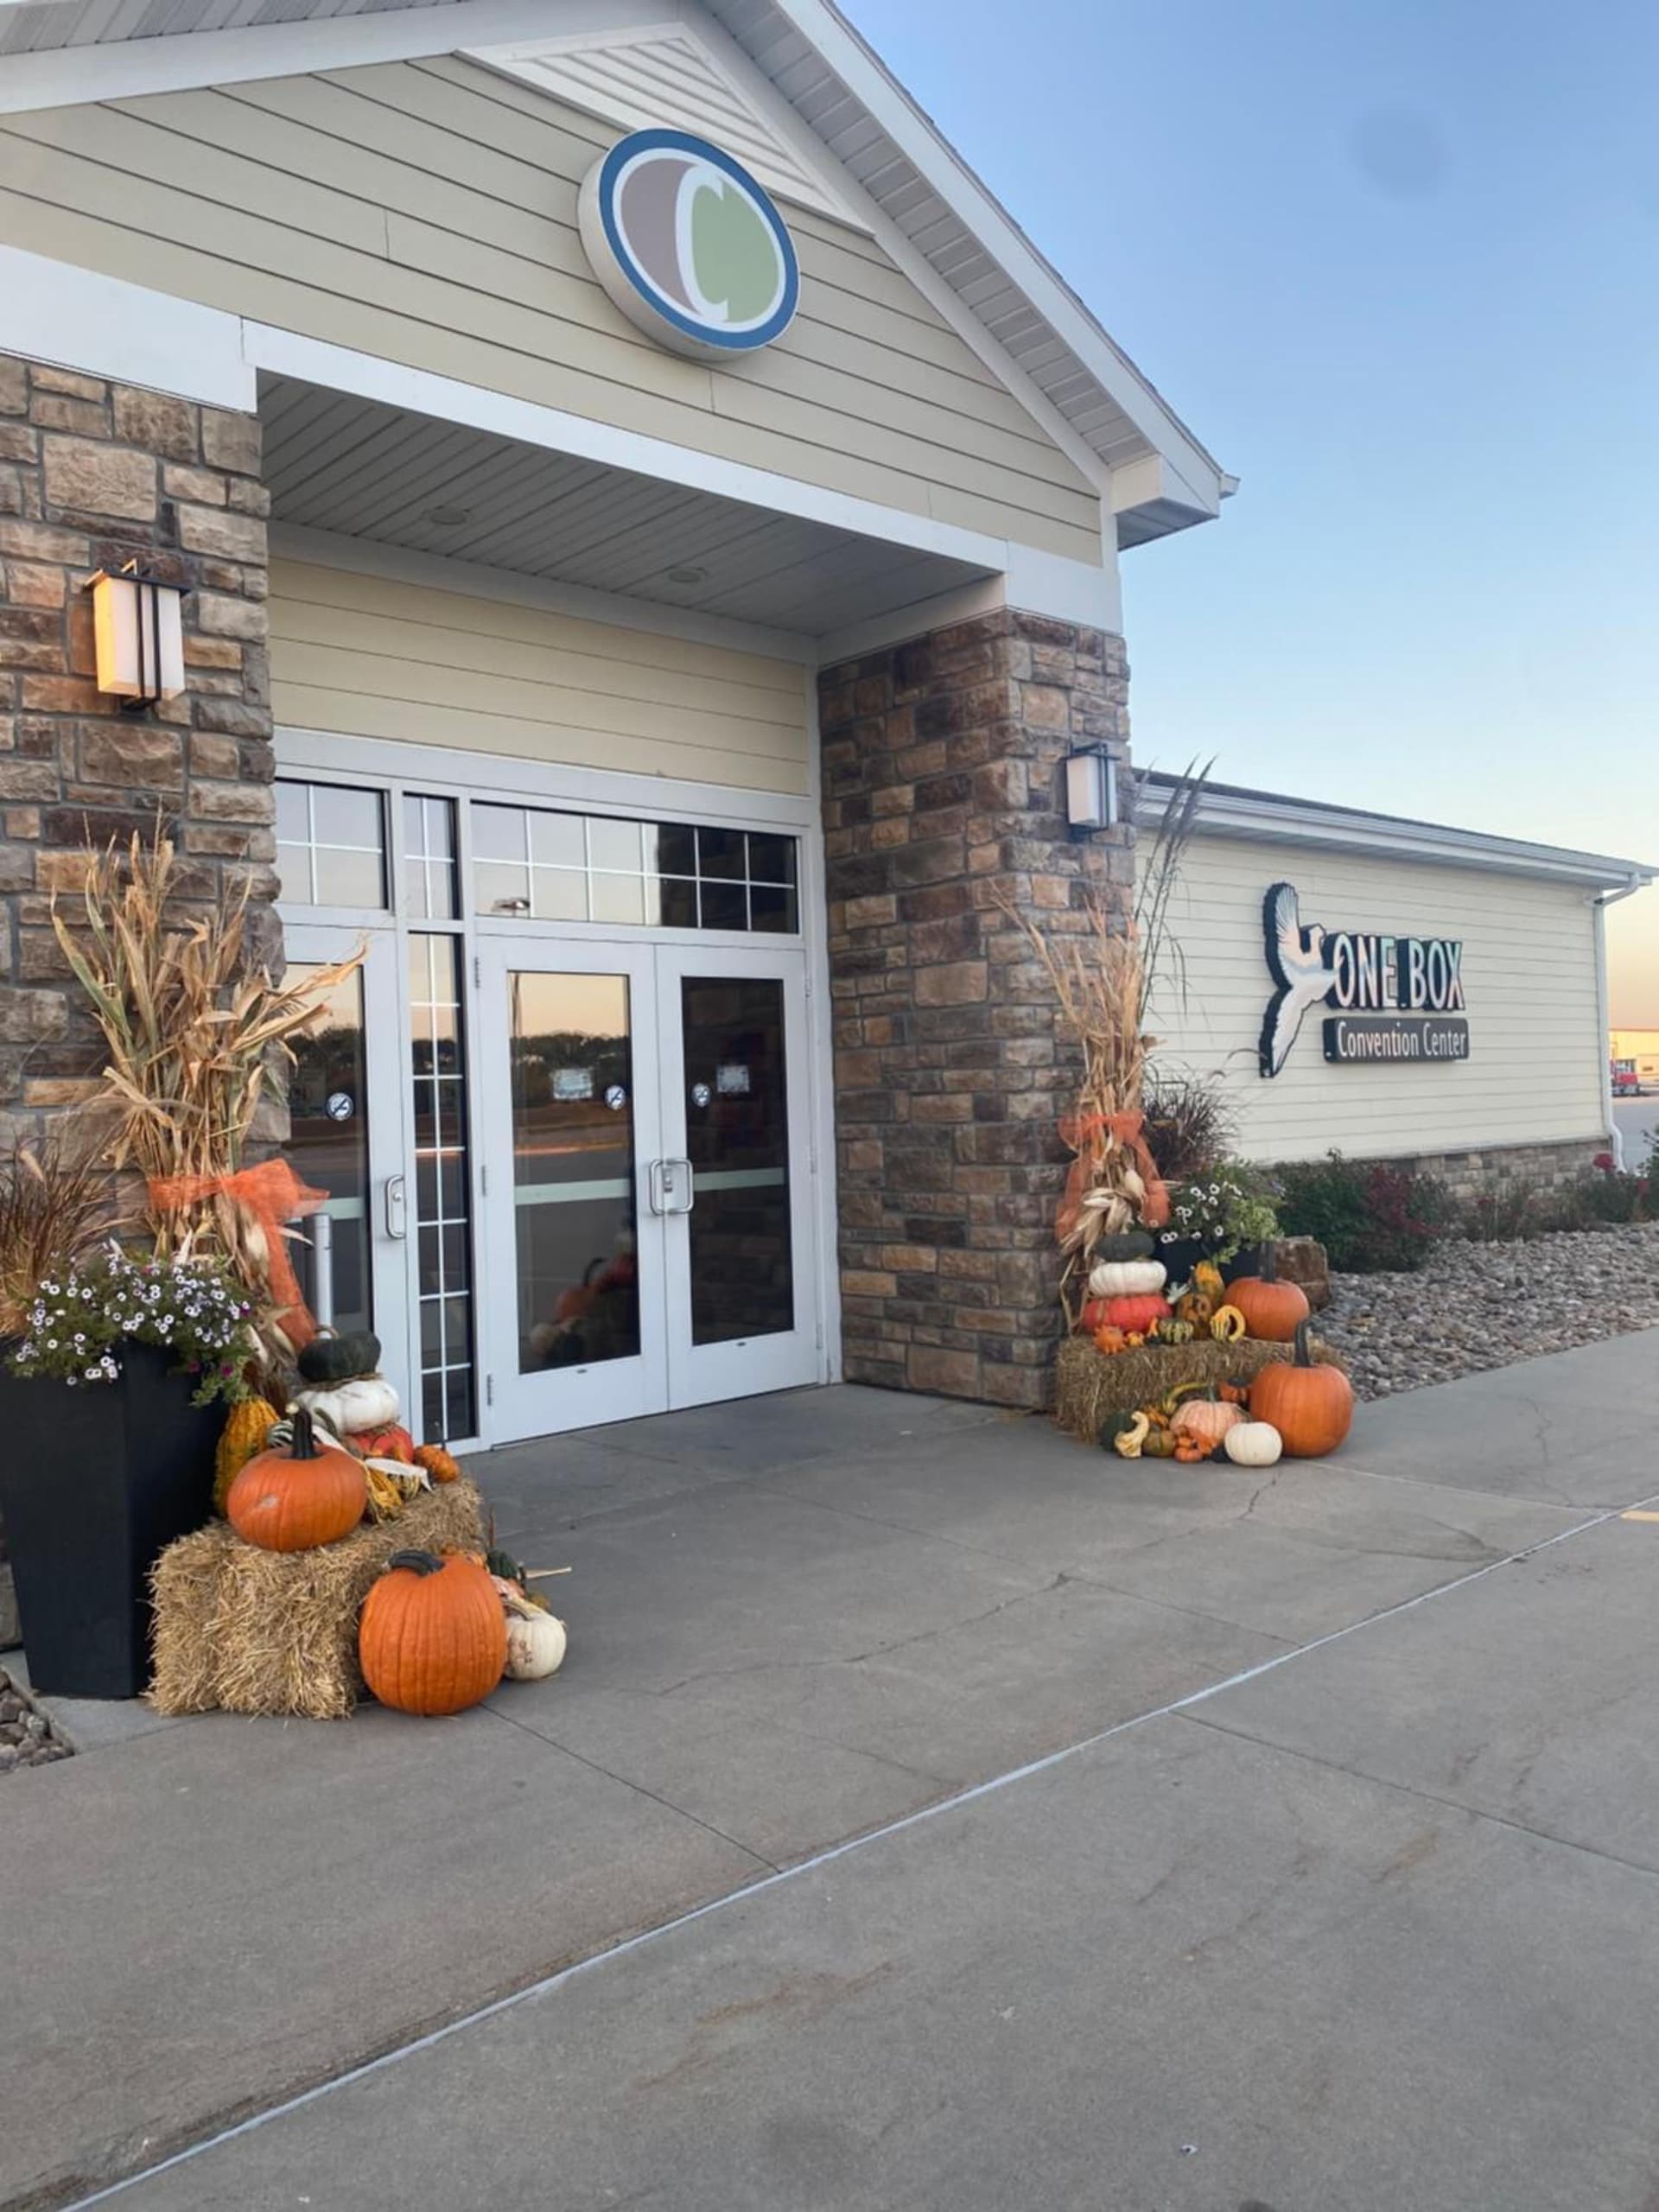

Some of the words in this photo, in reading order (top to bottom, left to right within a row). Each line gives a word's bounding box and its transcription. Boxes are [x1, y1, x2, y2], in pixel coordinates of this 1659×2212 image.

[1332, 933, 1397, 1007] ONE
[1408, 938, 1465, 1009] BOX
[1338, 1021, 1419, 1057] Convention
[1423, 1023, 1465, 1056] Center
